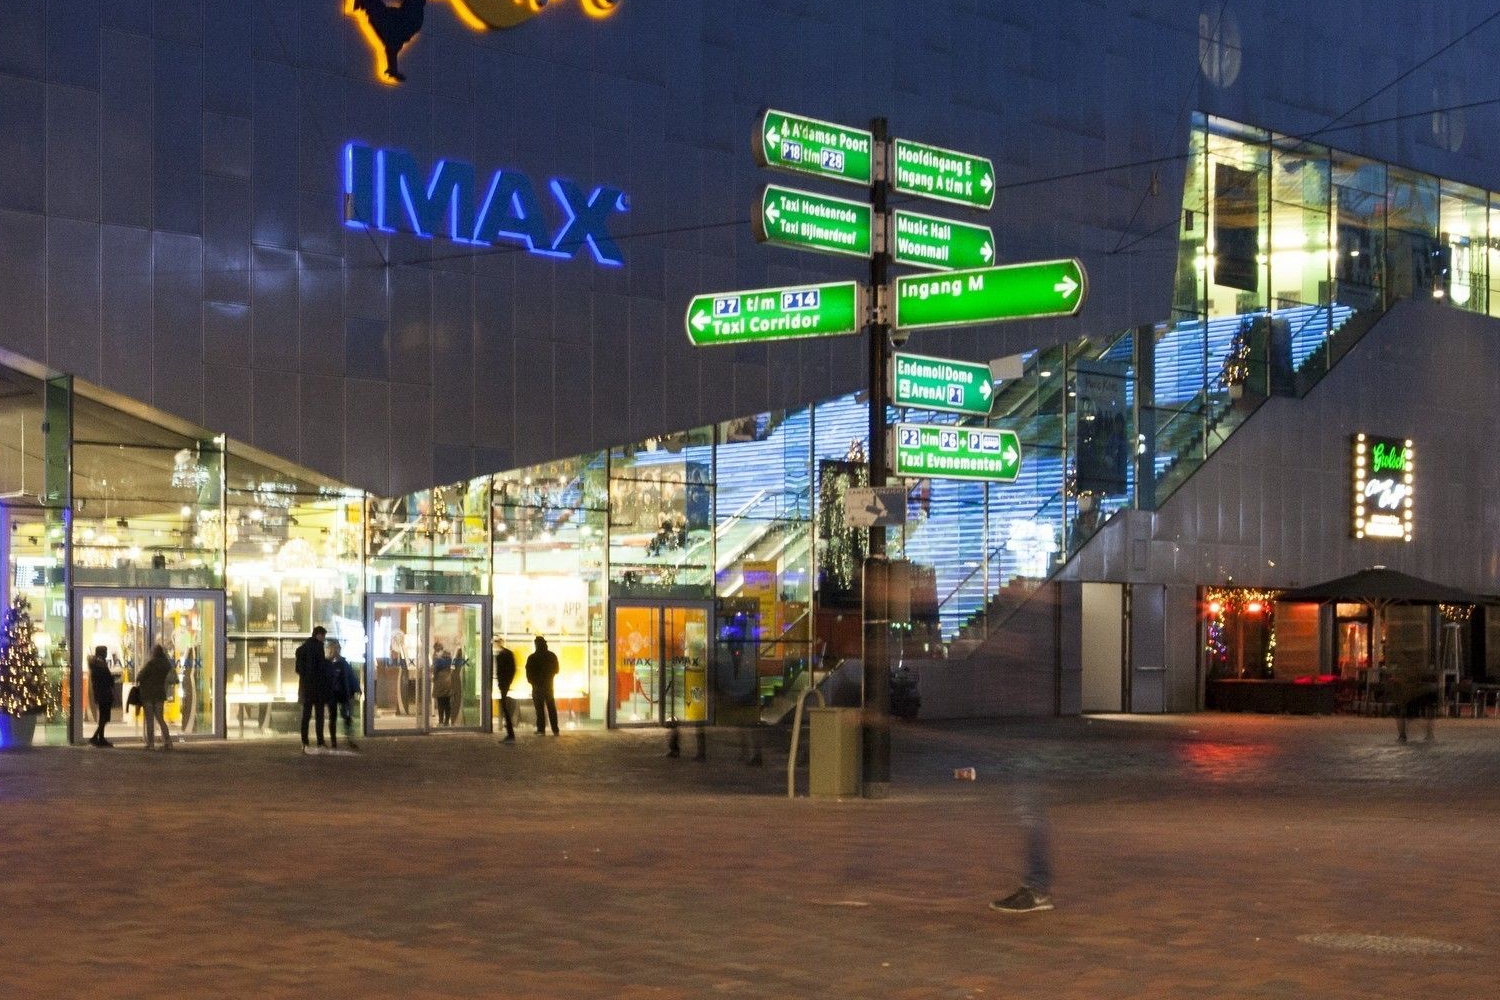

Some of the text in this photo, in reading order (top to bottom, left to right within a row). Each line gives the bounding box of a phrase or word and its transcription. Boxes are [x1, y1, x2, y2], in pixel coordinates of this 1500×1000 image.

[839, 133, 868, 153] Poort
[783, 143, 800, 159] P18
[822, 151, 842, 169] P28
[898, 146, 972, 177] Hoofdingang E
[898, 167, 933, 191] Ingang
[936, 175, 943, 190] A
[965, 181, 972, 196] K
[345, 143, 624, 266] IMAX
[780, 196, 857, 223] Taxi Hoekenrode
[780, 219, 857, 245] Taxi Bijlmerdreef
[898, 217, 951, 240] Music Hall
[898, 237, 949, 261] Woonmall
[902, 276, 984, 300] Ingang M
[716, 292, 816, 315] P7 t/m P14
[713, 313, 820, 335] Taxi Corridor
[949, 387, 962, 403] P1
[901, 430, 918, 445] P2
[942, 432, 957, 448] P6
[970, 435, 979, 448] P
[900, 452, 1002, 471] Taxi Evenementen
